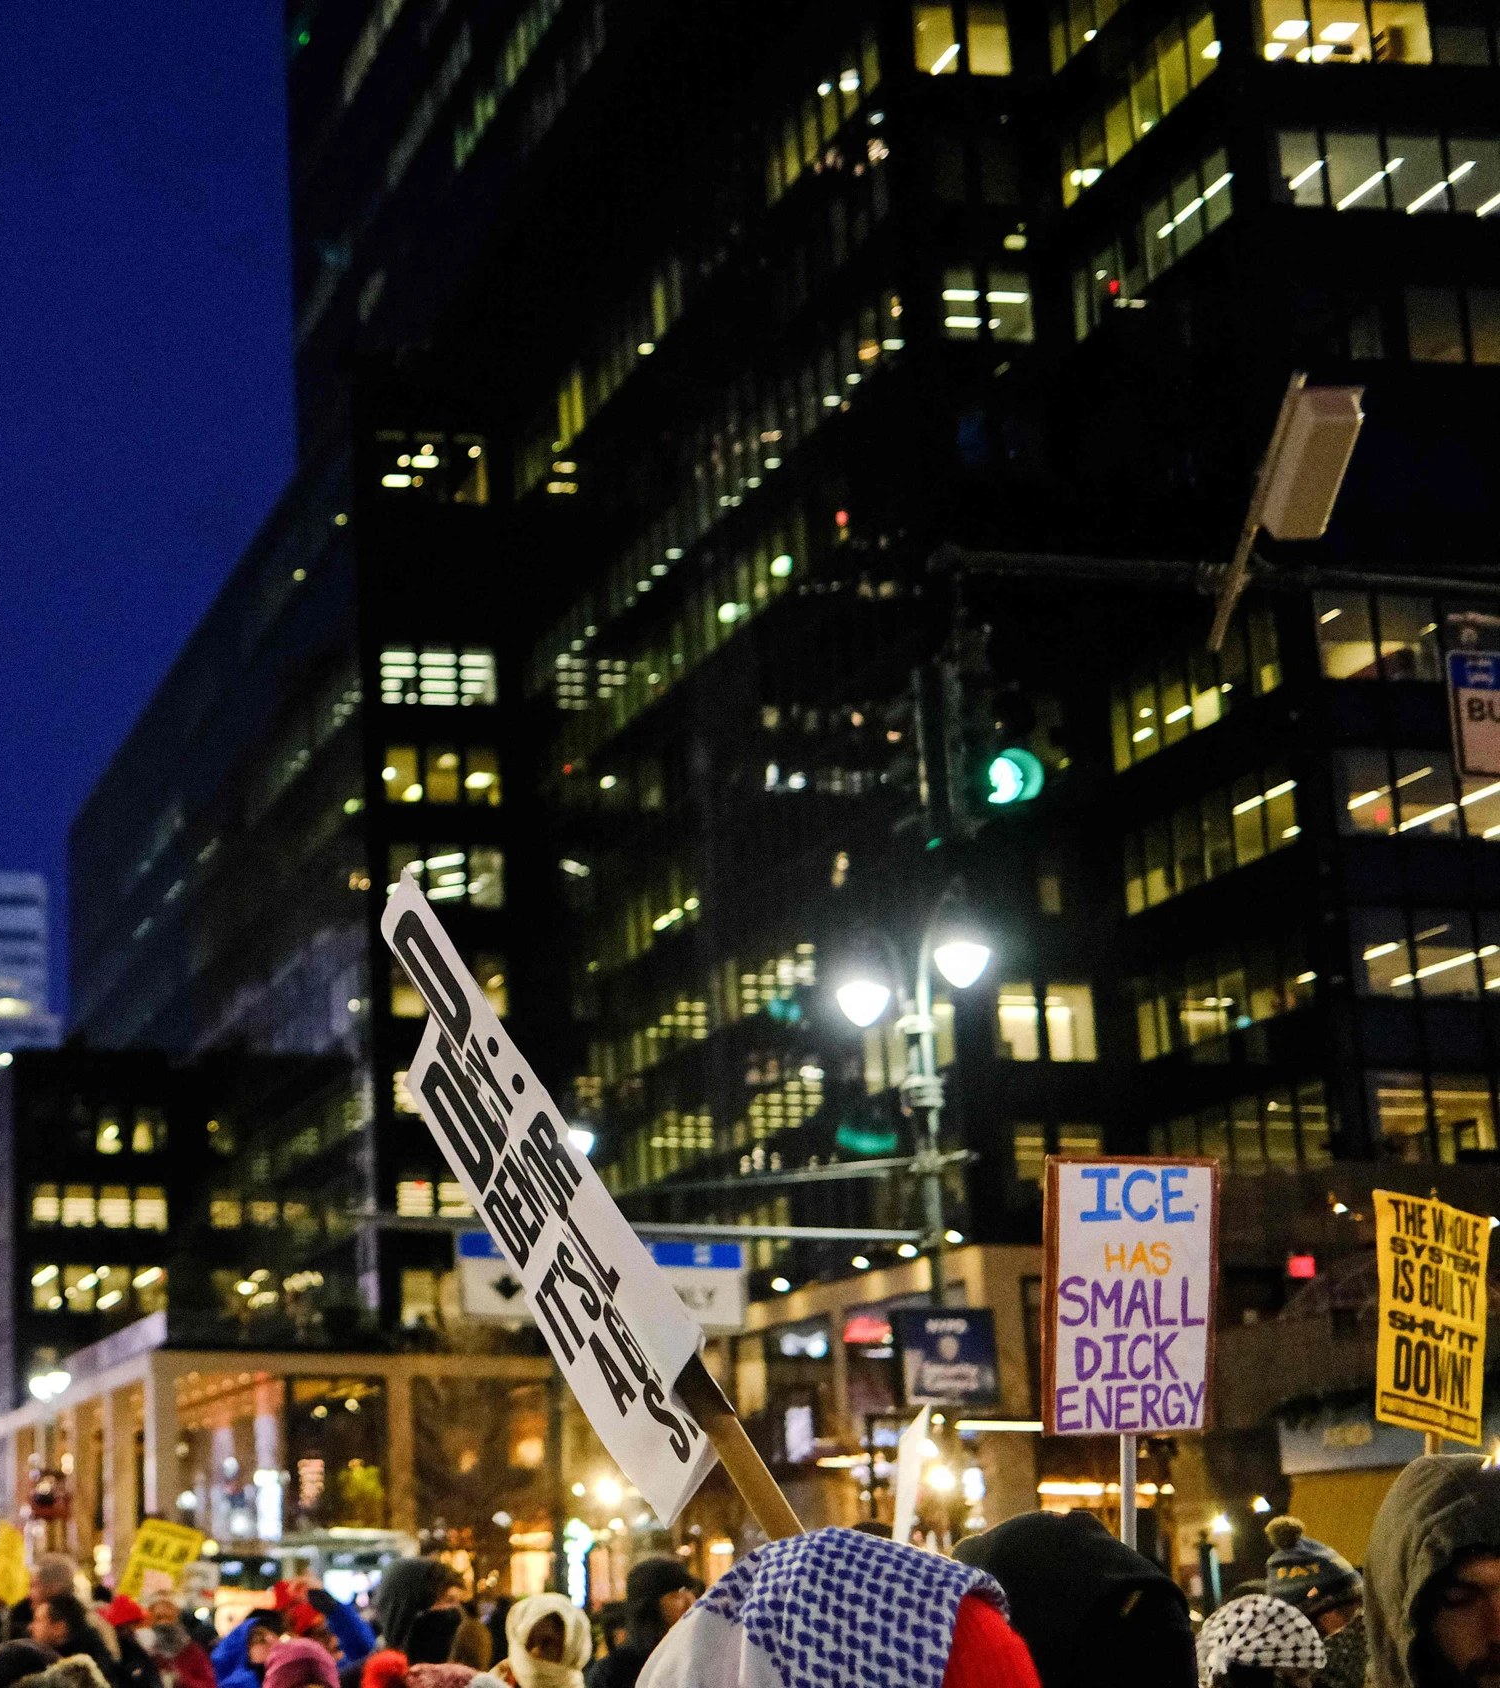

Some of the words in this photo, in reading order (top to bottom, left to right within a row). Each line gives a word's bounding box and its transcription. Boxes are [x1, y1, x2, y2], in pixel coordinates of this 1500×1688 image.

[1387, 1198, 1428, 1240] THE
[1104, 1241, 1173, 1276] HAS
[1389, 1236, 1481, 1278] SYSTEM
[535, 1241, 601, 1366] IT'S
[1058, 1275, 1206, 1328] SMALL
[1392, 1257, 1415, 1304] IS
[1419, 1264, 1478, 1323] GUILTY
[1074, 1331, 1180, 1382] DICK
[1387, 1309, 1456, 1345] SHUT
[1458, 1331, 1479, 1354] IT
[1393, 1334, 1472, 1411] DOWN!
[1056, 1381, 1206, 1432] ENERGY
